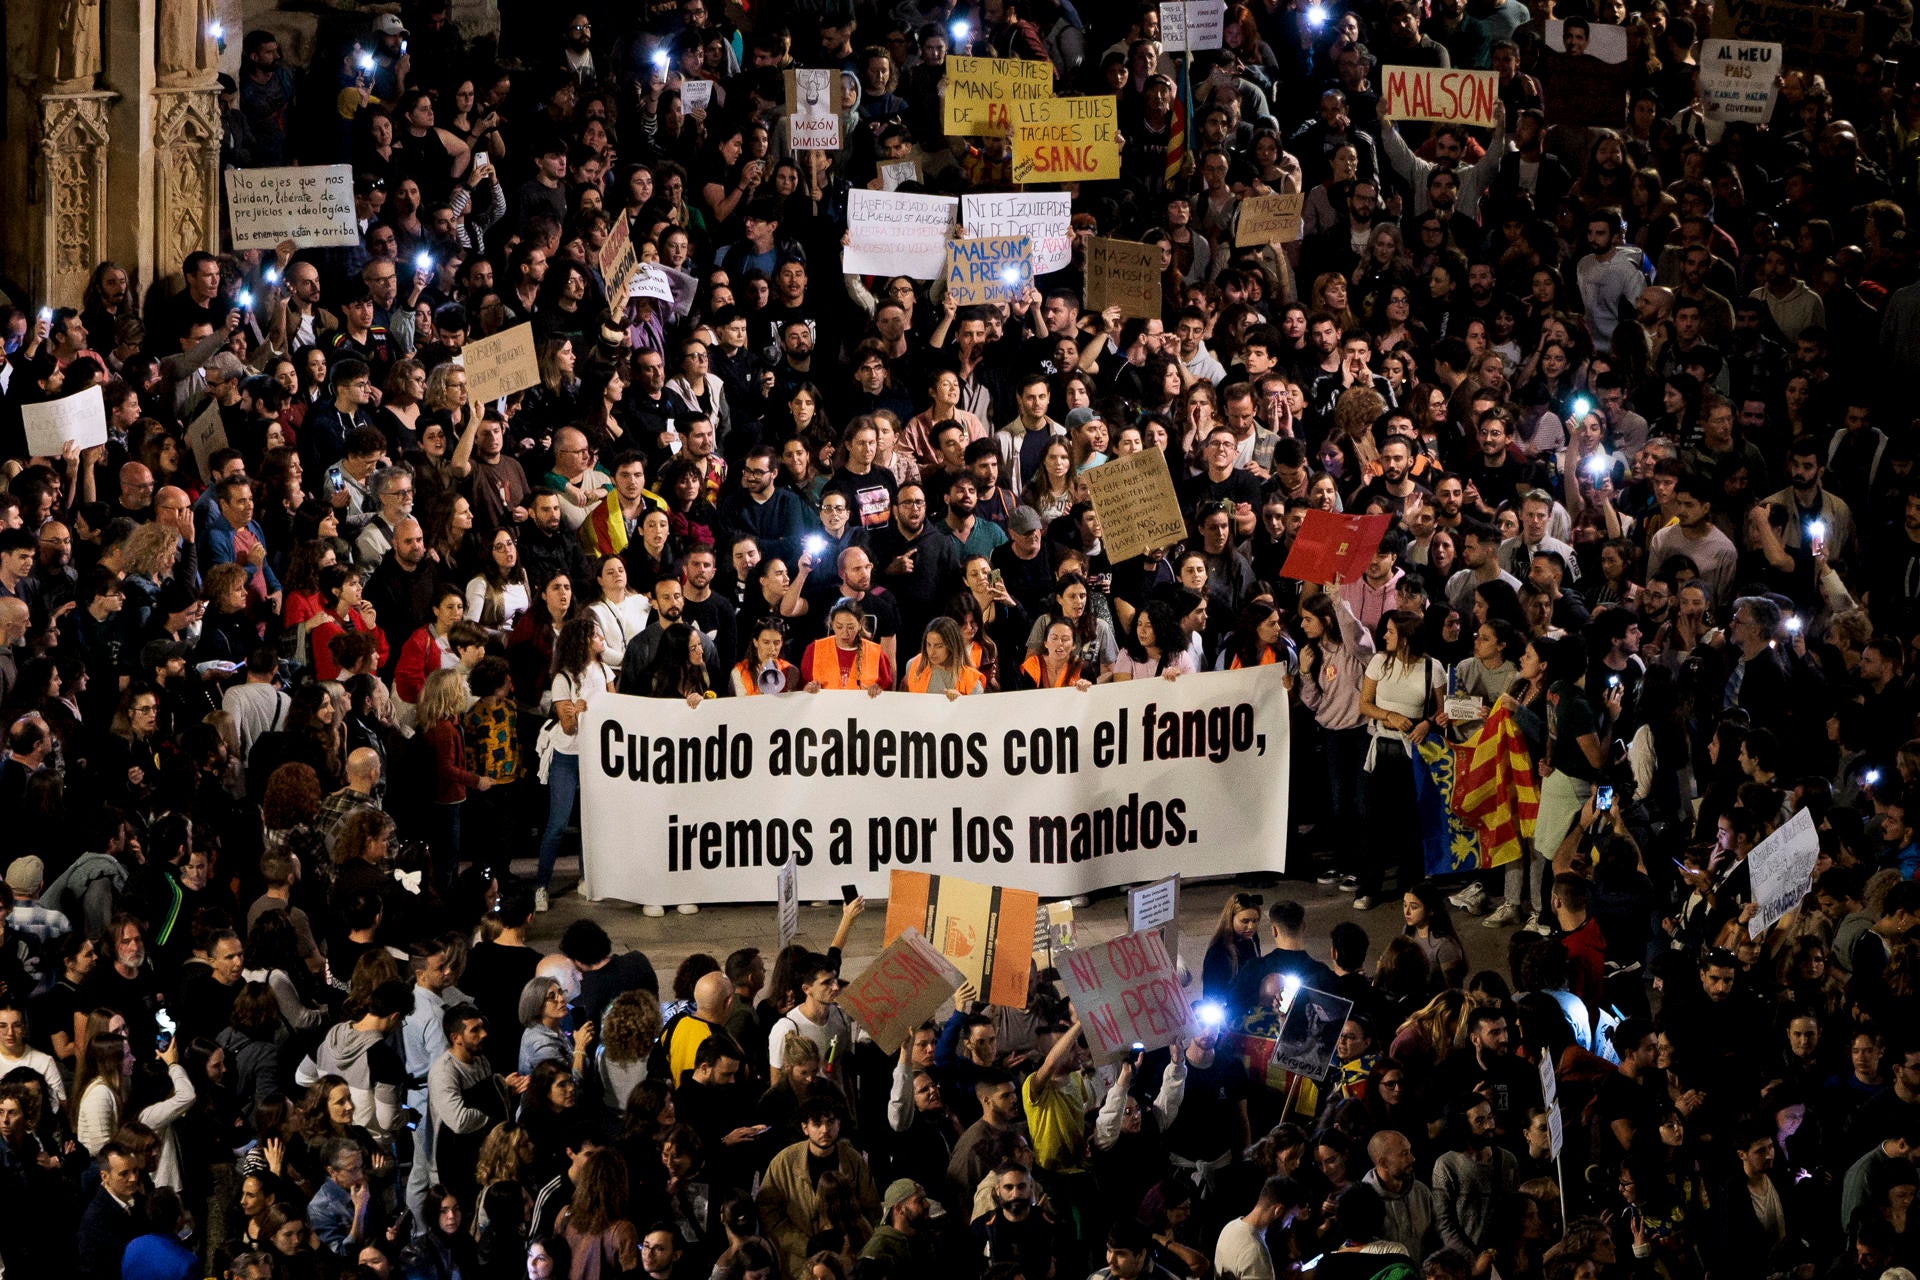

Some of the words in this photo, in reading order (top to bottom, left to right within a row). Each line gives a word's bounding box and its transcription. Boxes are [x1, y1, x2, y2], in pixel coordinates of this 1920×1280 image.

[1718, 46, 1732, 60] AL
[1737, 47, 1772, 62] MEU
[956, 59, 977, 74] LES
[992, 60, 1049, 81] NOSTRES
[953, 80, 1004, 100] MANS
[1012, 83, 1051, 100] PLENES
[1387, 71, 1494, 122] MALSON
[953, 107, 973, 123] DE
[1020, 102, 1050, 123] LES
[1068, 99, 1113, 120] TEUES
[795, 118, 834, 131] MAZÓN
[1020, 124, 1082, 142] TACADES
[1095, 123, 1111, 142] DE
[792, 133, 838, 147] DIMISSIÓ
[1033, 145, 1099, 173] SANG
[233, 174, 253, 189] No
[260, 176, 291, 191] dejes
[298, 177, 316, 190] que
[325, 176, 344, 185] nos
[232, 191, 273, 205] dividan,
[275, 192, 312, 204] libérate
[320, 189, 337, 201] de
[235, 207, 283, 222] prejuicios
[298, 202, 351, 220] ideologías
[991, 202, 1004, 217] DE
[1006, 197, 1072, 217] IZQUIERDAS
[852, 212, 866, 221] EL
[868, 214, 903, 223] PUEBLO
[905, 214, 914, 222] SE
[252, 230, 289, 243] enemigos
[291, 224, 311, 238] están
[322, 222, 355, 236] arriba
[991, 223, 1004, 237] DE
[950, 265, 964, 283] A
[1088, 471, 1103, 484] LA
[1104, 482, 1120, 493] QUE
[1137, 517, 1156, 531] NOS
[1148, 519, 1181, 538] MATADO
[601, 719, 755, 786] Cuando
[769, 718, 989, 780] acabemos
[1004, 726, 1080, 778] con
[1094, 707, 1129, 770] el
[1142, 702, 1268, 765] fango,
[668, 815, 815, 873] iremos
[830, 818, 854, 868] a
[869, 817, 938, 881] por
[953, 808, 1015, 865] los
[1030, 793, 1199, 865] mandos.
[1069, 951, 1102, 993] NI
[1087, 1003, 1124, 1051] NI
